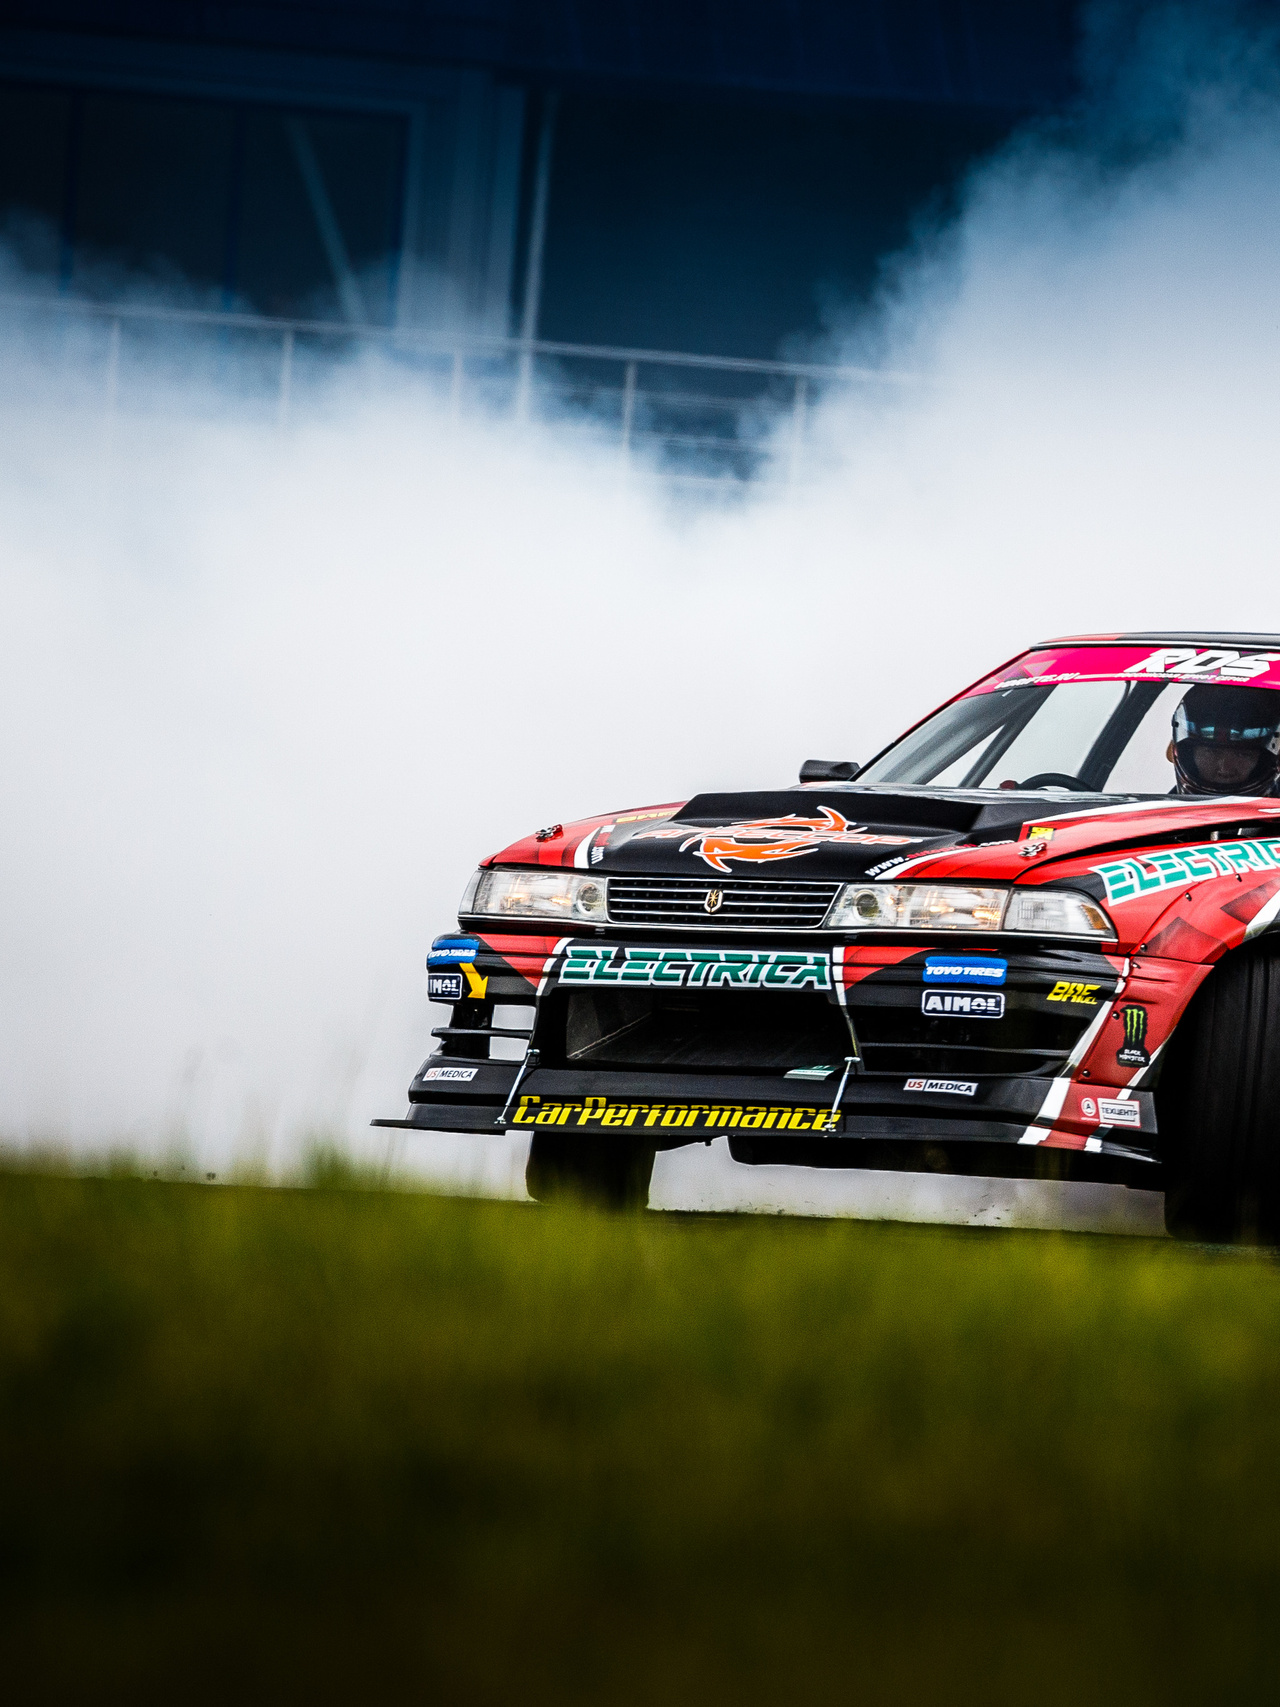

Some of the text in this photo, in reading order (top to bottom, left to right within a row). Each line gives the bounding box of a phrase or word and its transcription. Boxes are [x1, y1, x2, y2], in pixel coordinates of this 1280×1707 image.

[558, 946, 832, 990] ELECTRICA
[926, 966, 1005, 977] TOYO TIRES
[428, 979, 459, 994] IMOL
[925, 996, 1000, 1011] AIMOL
[441, 1070, 473, 1078] MEDICA
[927, 1082, 972, 1093] MEDICA
[512, 1096, 842, 1131] CarPerformance
